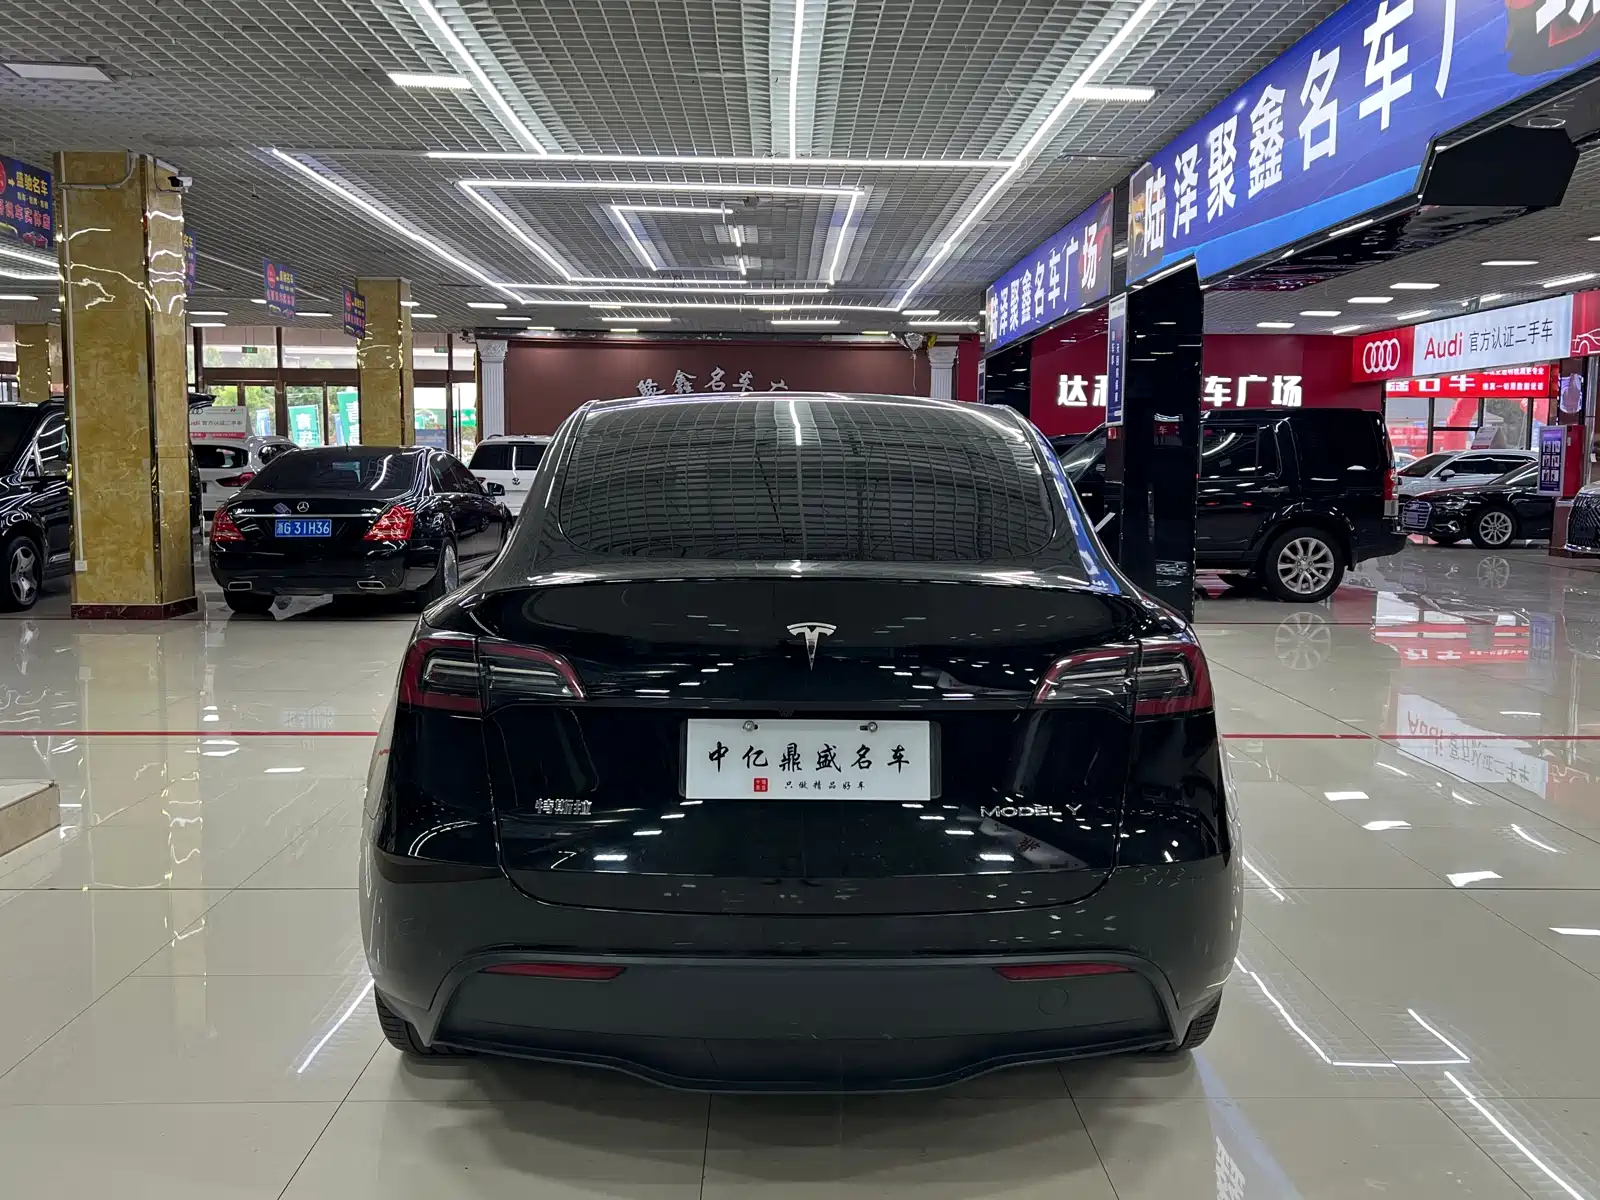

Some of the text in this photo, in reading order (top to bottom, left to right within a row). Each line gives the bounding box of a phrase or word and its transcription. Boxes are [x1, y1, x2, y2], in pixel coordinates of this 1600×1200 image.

[1142, 0, 1600, 258] 陆泽聚鑫名车
[989, 222, 1098, 343] 陆泽聚鑫名车广场
[1424, 318, 1553, 360] Audi 官方认证二手车
[708, 740, 910, 774] 中亿鼎盛名车
[784, 780, 867, 790] 只做精品好车
[535, 798, 593, 815] 特斯拉
[981, 804, 1083, 818] MODEL Y
